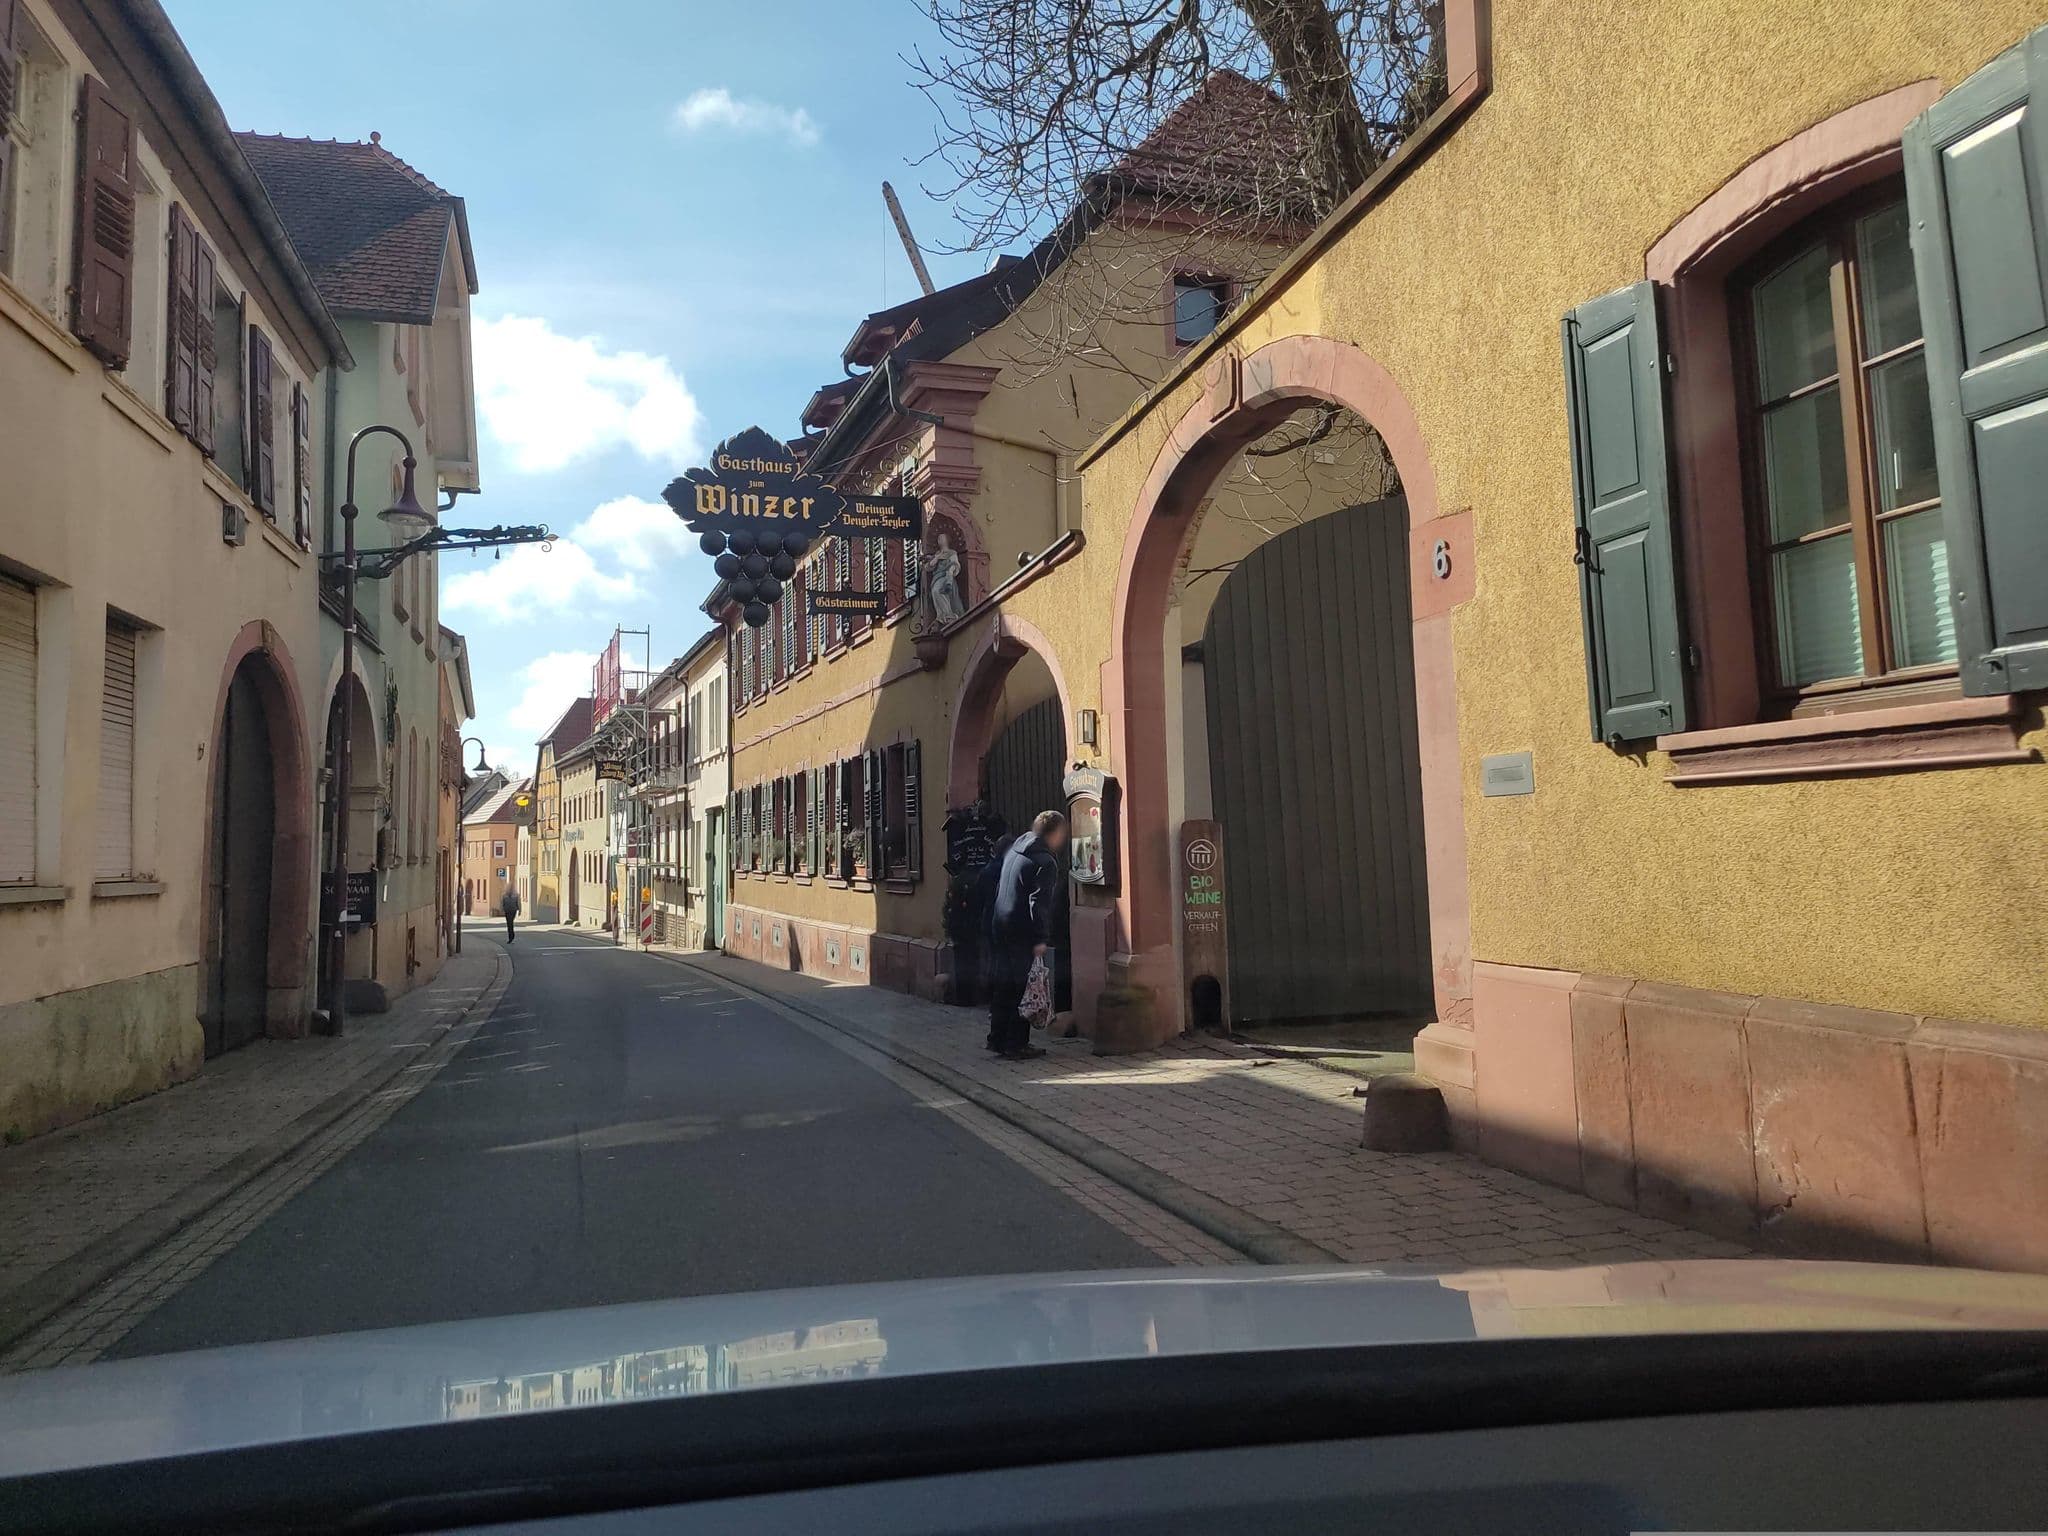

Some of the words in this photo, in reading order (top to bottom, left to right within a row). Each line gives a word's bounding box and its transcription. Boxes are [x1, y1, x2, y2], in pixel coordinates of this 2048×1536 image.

[717, 453, 793, 475] Gasthaus
[747, 480, 765, 489] zum
[694, 484, 816, 520] Winzer
[855, 502, 895, 516] Weingut
[842, 513, 911, 529] Dengler-Seyler
[1432, 538, 1450, 578] 6
[815, 596, 879, 609] Gästezimmer
[1190, 875, 1214, 889] BIO
[1184, 891, 1221, 904] WEINE
